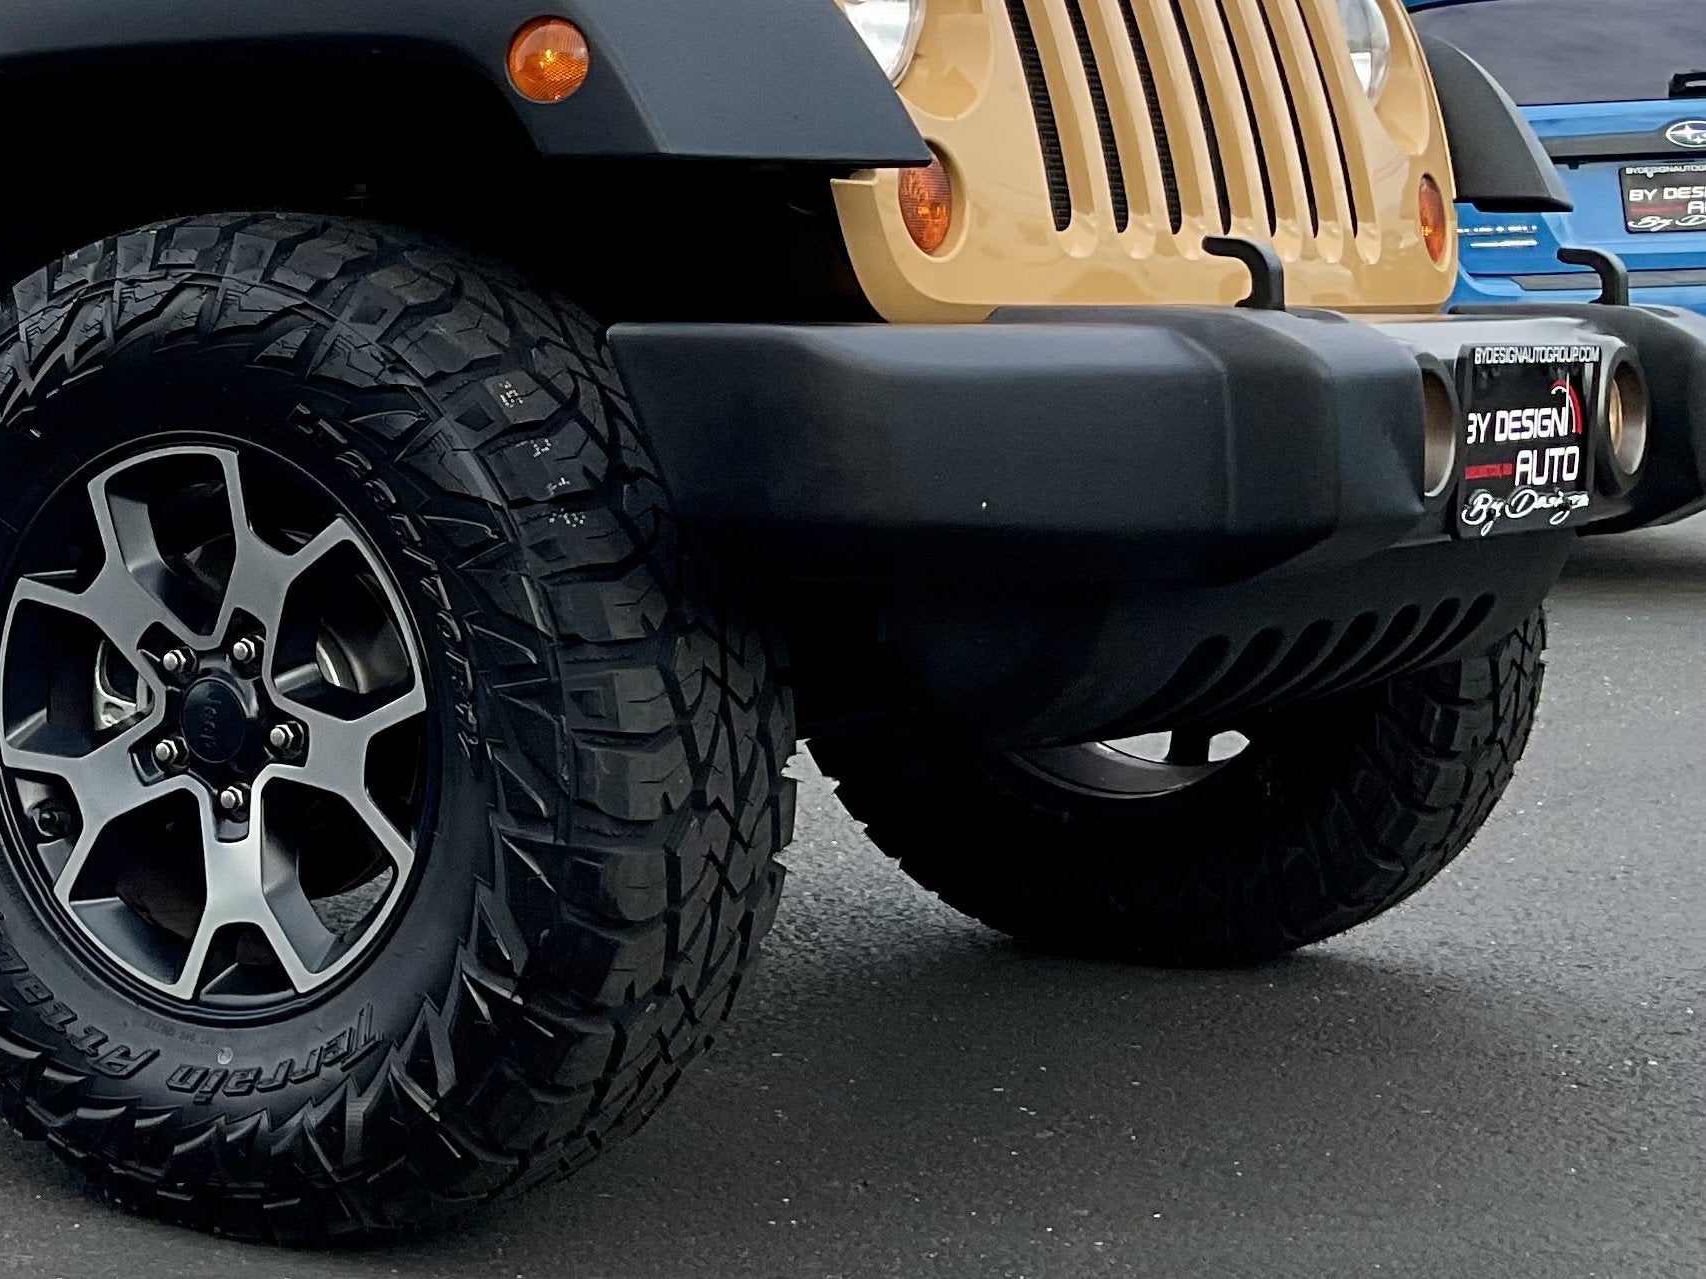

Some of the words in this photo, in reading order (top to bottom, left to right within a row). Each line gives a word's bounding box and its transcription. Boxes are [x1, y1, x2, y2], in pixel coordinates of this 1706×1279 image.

[1629, 189, 1657, 201] BY
[1474, 345, 1600, 365] BYDESIGNAUTOGROUP.COM
[1466, 412, 1491, 445] BY
[1494, 407, 1569, 442] DESIGN
[1514, 445, 1580, 487] AUTO
[166, 1001, 385, 1104] Terrain
